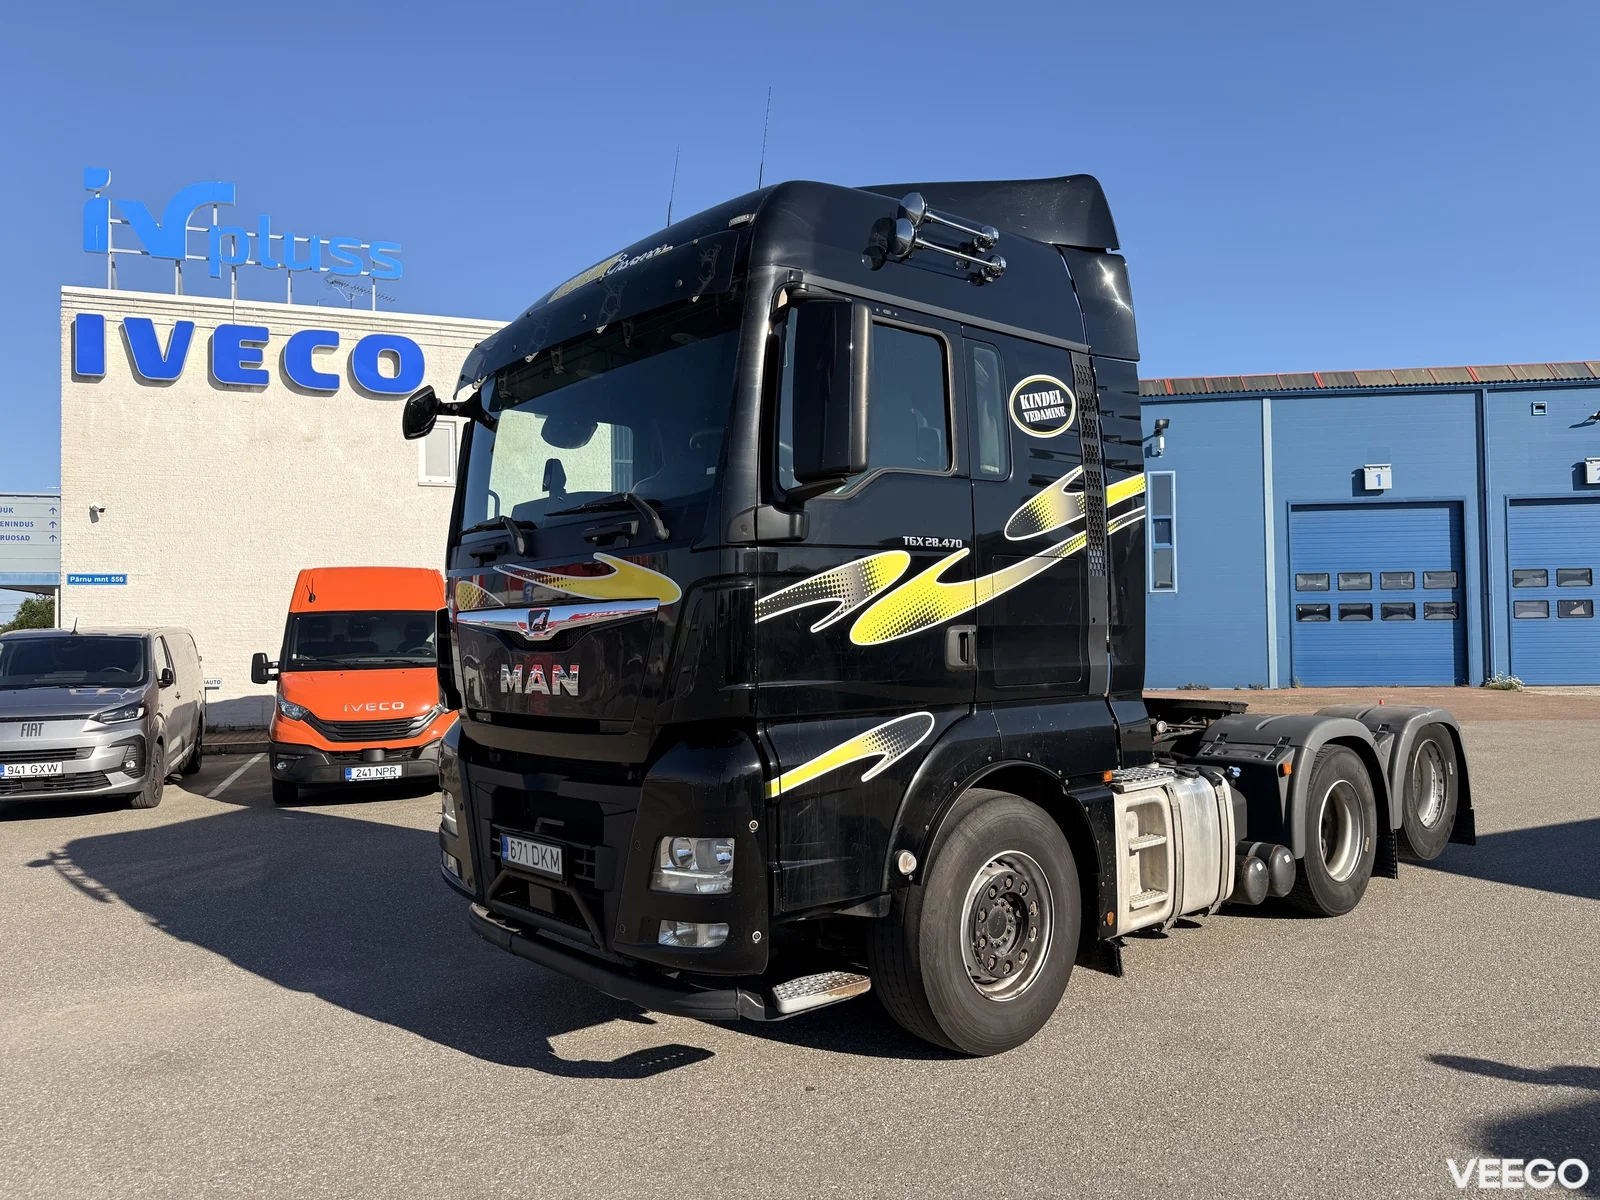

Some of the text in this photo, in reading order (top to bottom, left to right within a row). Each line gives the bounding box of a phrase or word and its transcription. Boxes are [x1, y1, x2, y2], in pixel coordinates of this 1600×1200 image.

[73, 313, 426, 396] IVECO
[1019, 389, 1064, 410] KINDEL
[1023, 405, 1067, 423] VEDAMINE
[1375, 473, 1382, 487] 1
[902, 535, 963, 549] TGX 28.470
[500, 664, 580, 697] MAN
[343, 701, 405, 712] IVECO
[20, 722, 44, 738] FIAT
[7, 763, 58, 775] 941 GXW
[356, 768, 372, 778] 241
[375, 766, 397, 776] NPR
[510, 840, 560, 872] 671 DKM
